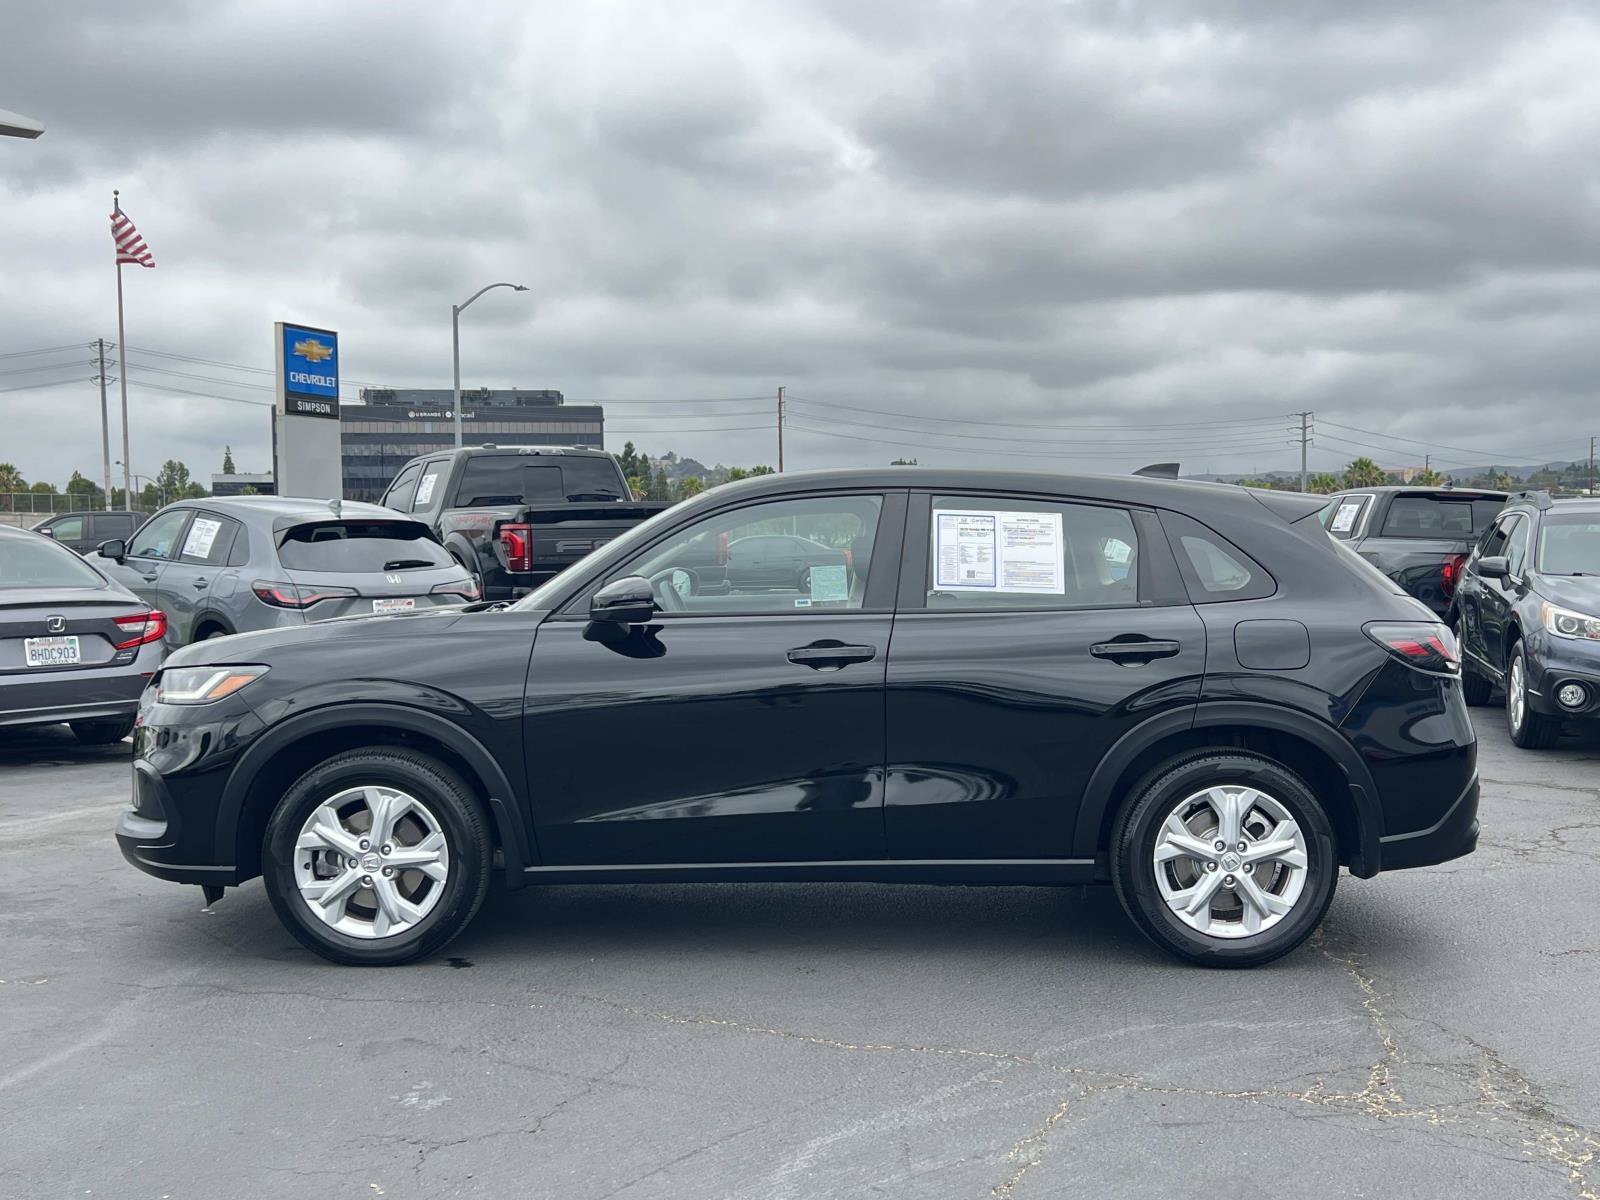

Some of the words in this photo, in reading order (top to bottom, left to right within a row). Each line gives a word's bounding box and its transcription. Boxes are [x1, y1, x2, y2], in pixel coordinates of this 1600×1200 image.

[290, 371, 337, 387] CHEVROLET
[297, 400, 331, 414] SIMPSON
[31, 646, 76, 661] 8HDC903
